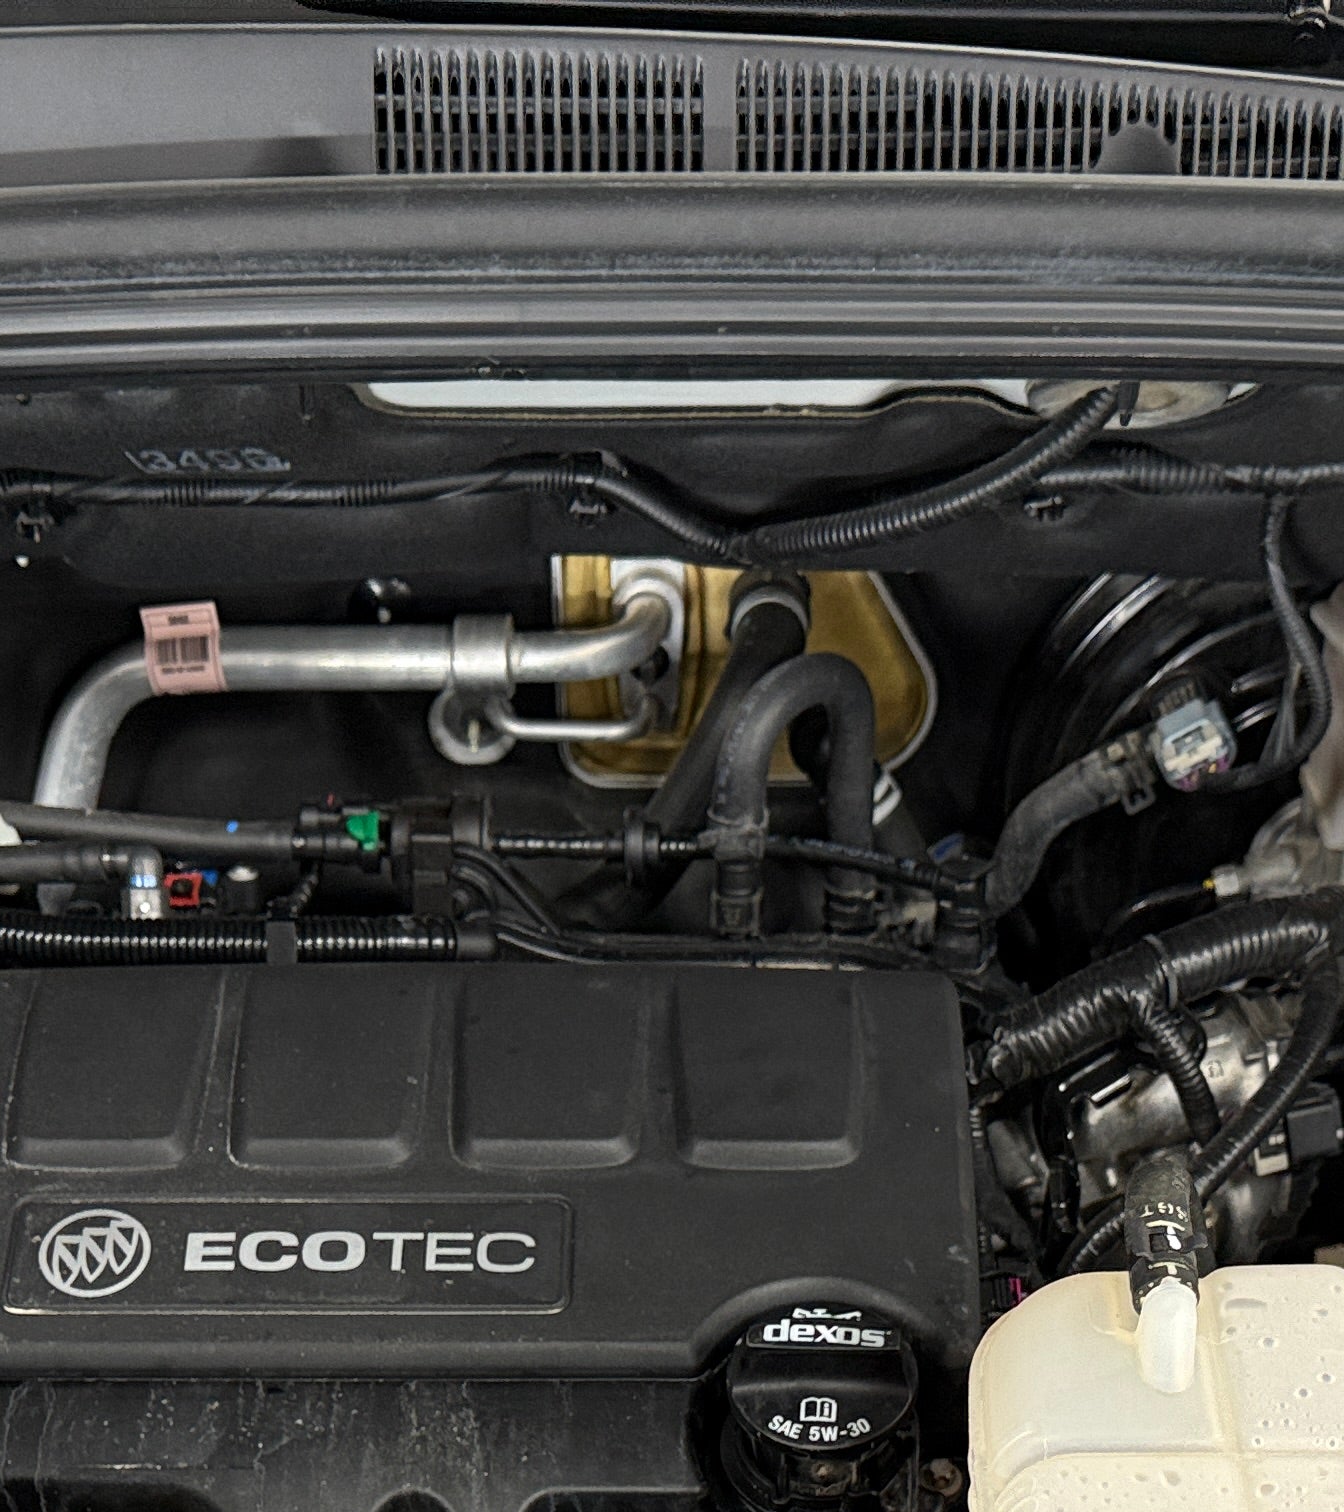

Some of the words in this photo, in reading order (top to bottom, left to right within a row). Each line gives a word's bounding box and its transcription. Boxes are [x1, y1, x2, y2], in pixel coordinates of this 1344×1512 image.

[184, 1231, 536, 1273] ECOTEC
[763, 1319, 886, 1348] dexos
[768, 1415, 804, 1440] SAE
[808, 1418, 872, 1442] 5W-30
